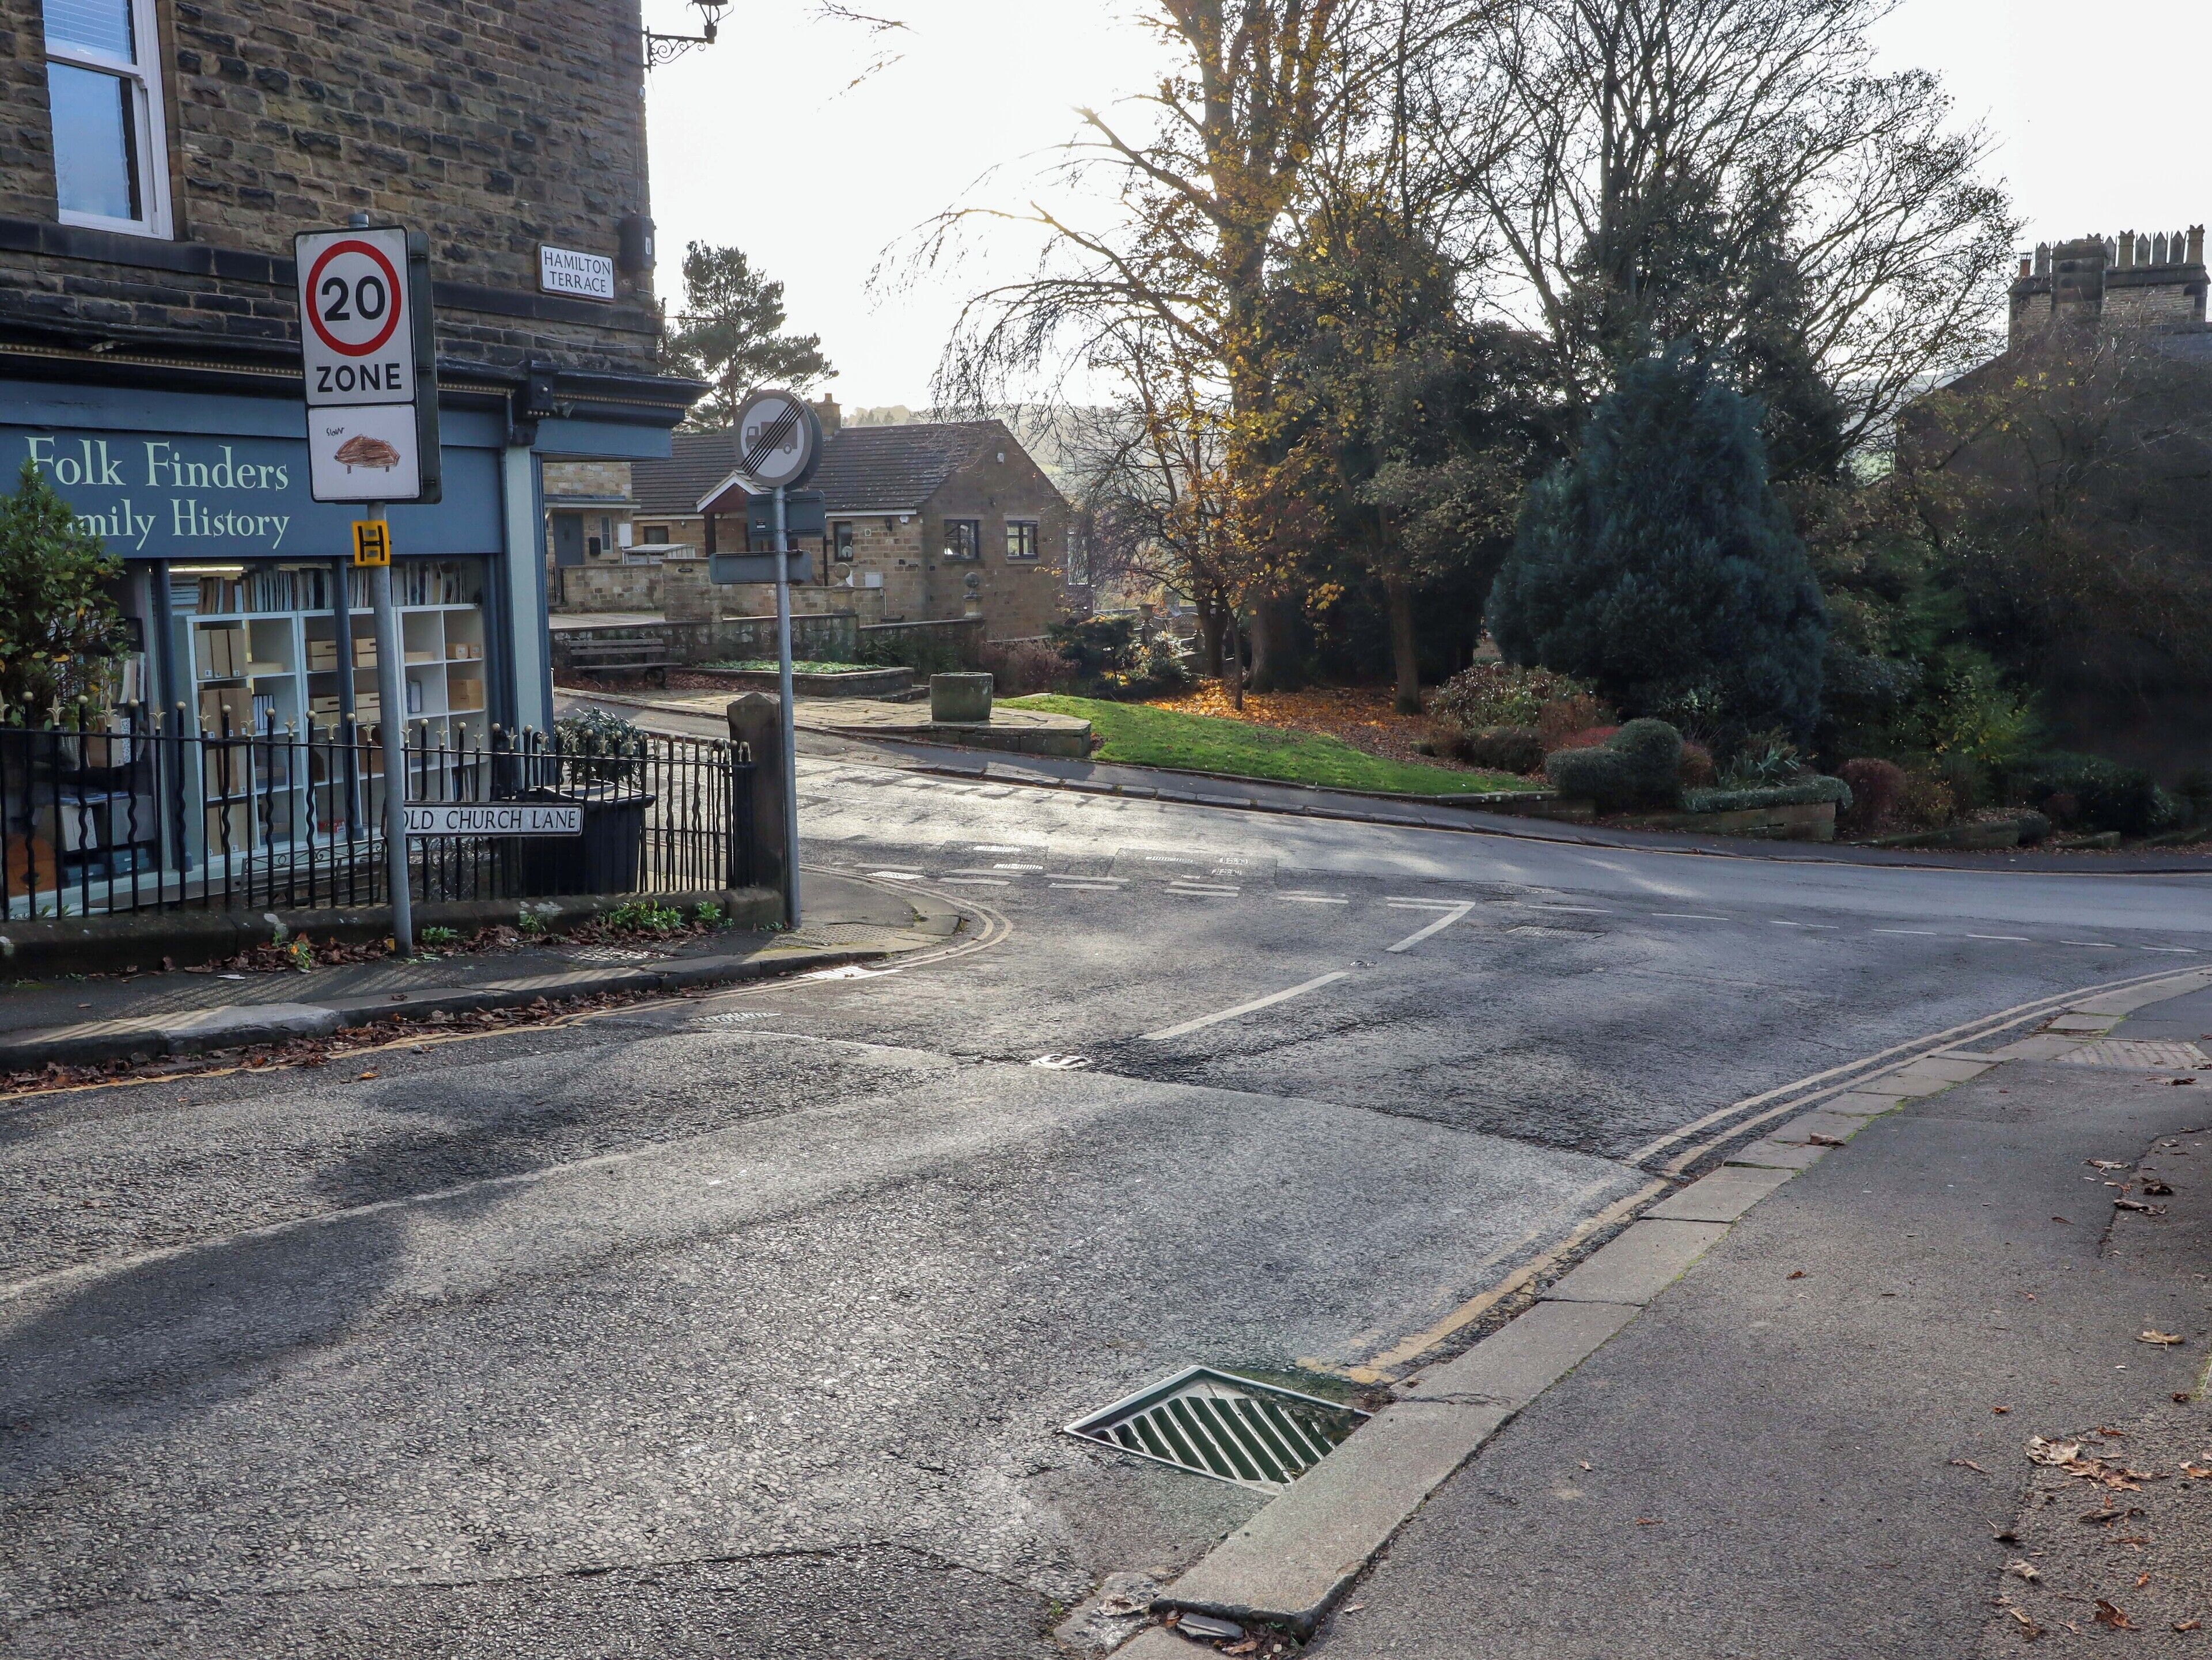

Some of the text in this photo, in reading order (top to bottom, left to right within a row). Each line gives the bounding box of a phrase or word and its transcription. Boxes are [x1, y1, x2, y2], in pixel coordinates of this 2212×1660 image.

[544, 251, 611, 276] HAMILTON
[321, 275, 385, 321] 20
[549, 271, 607, 293] TERRACE
[316, 363, 402, 392] ZONE
[24, 435, 289, 491] Folk Finders
[65, 498, 290, 551] mily History
[358, 525, 385, 562] H
[403, 810, 576, 830] LD CHURCH LANE
